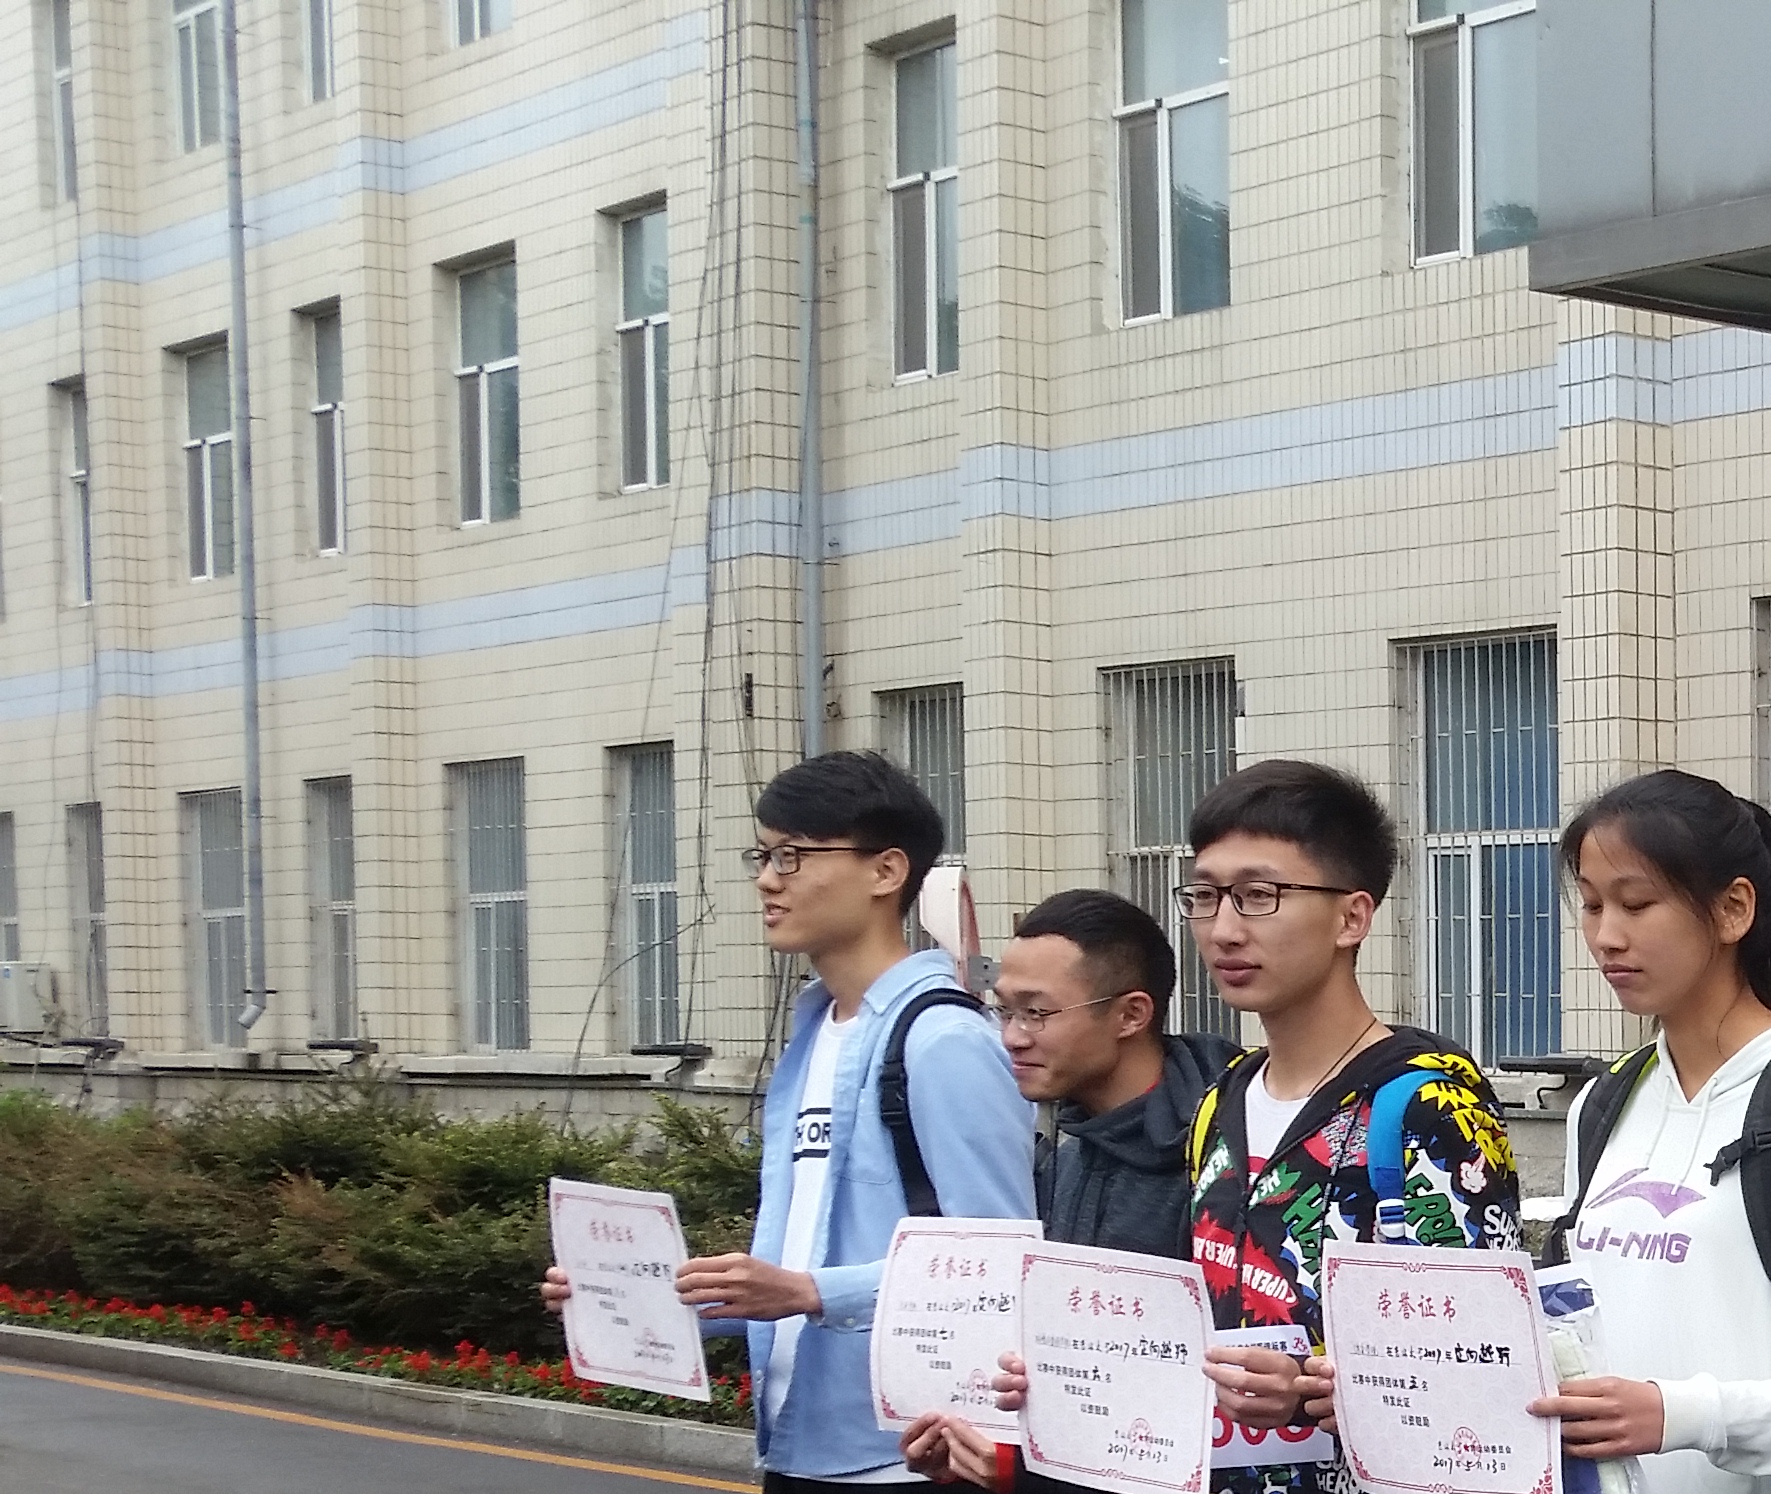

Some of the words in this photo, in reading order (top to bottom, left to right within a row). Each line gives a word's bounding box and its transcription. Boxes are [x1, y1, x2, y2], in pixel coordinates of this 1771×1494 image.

[1576, 1221, 1692, 1264] LI-NING
[1068, 1286, 1144, 1321] 荣誉证书
[1377, 1289, 1457, 1321] 荣誉证书
